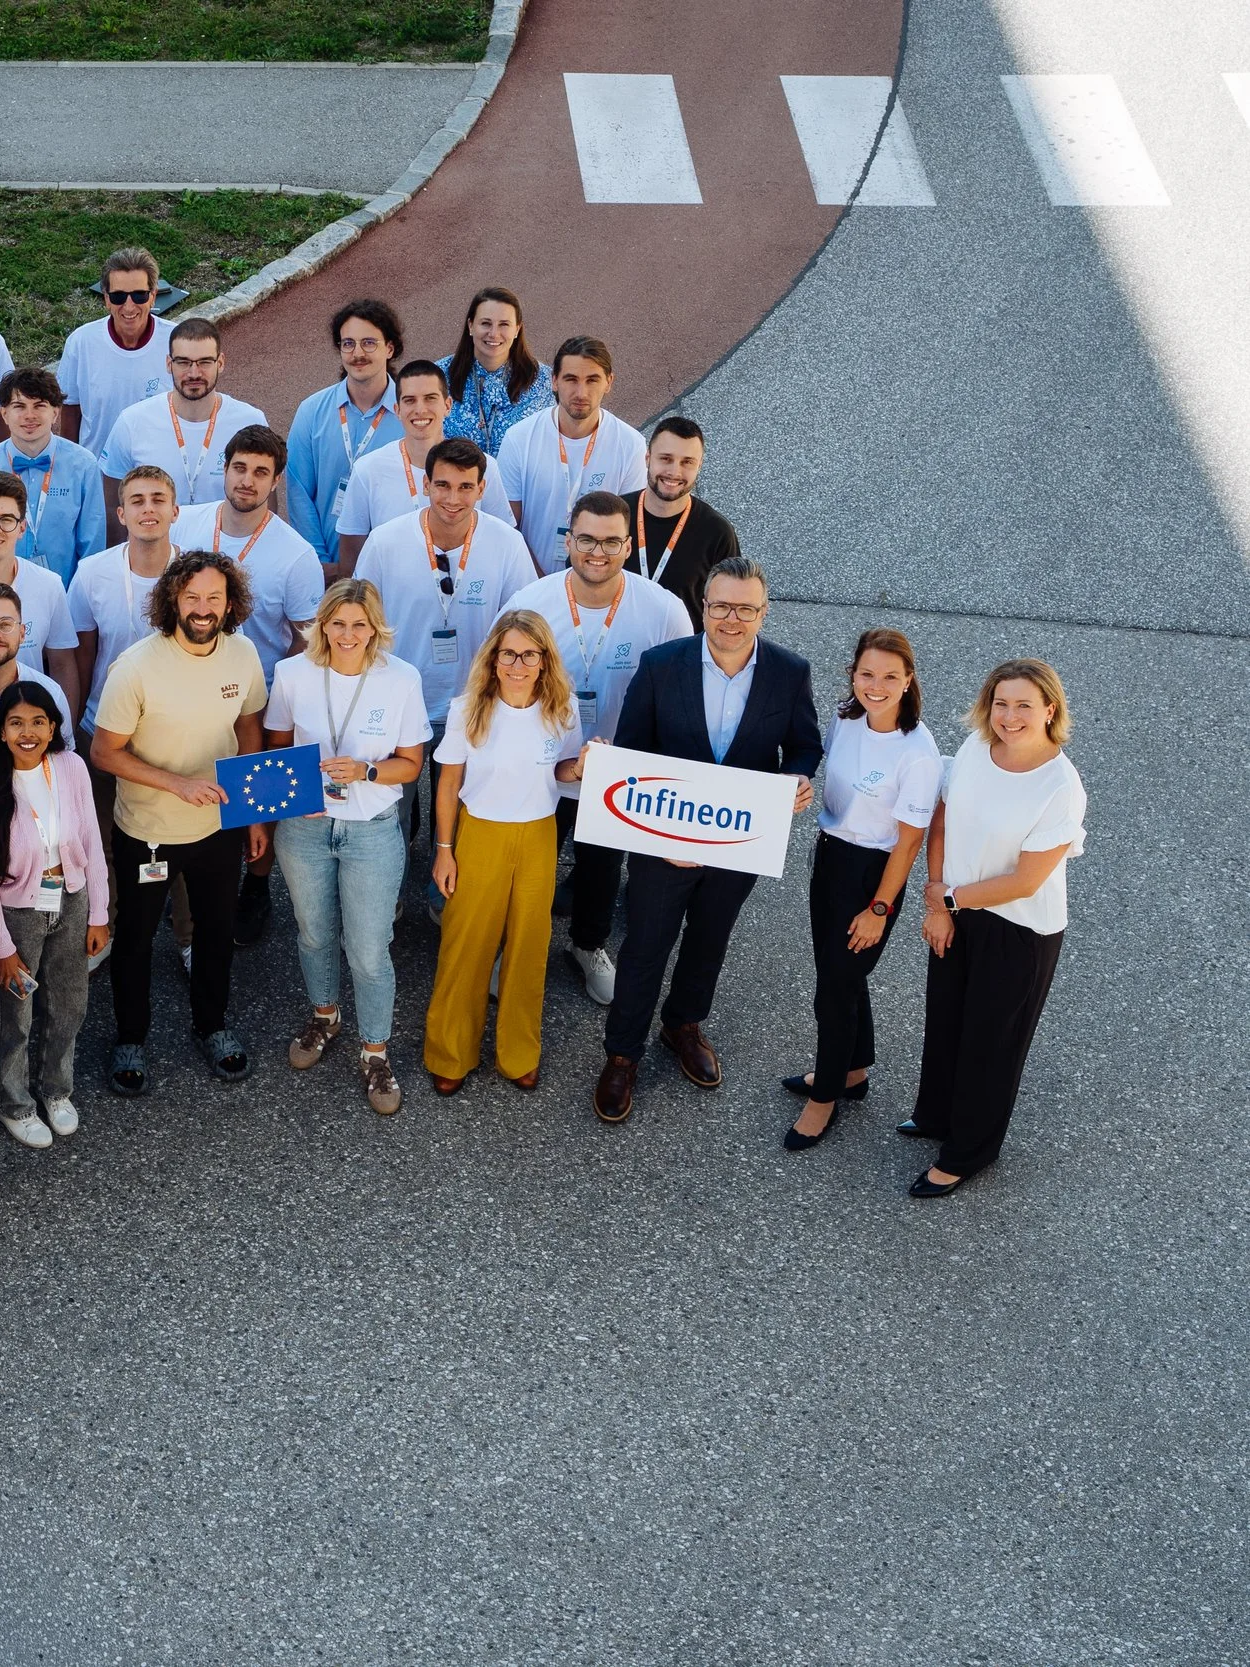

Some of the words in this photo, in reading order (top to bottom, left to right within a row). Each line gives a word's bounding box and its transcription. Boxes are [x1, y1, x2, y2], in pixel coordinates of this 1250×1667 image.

[221, 684, 239, 693] SALTY
[222, 691, 239, 700] CREW
[626, 776, 752, 832] infineon
